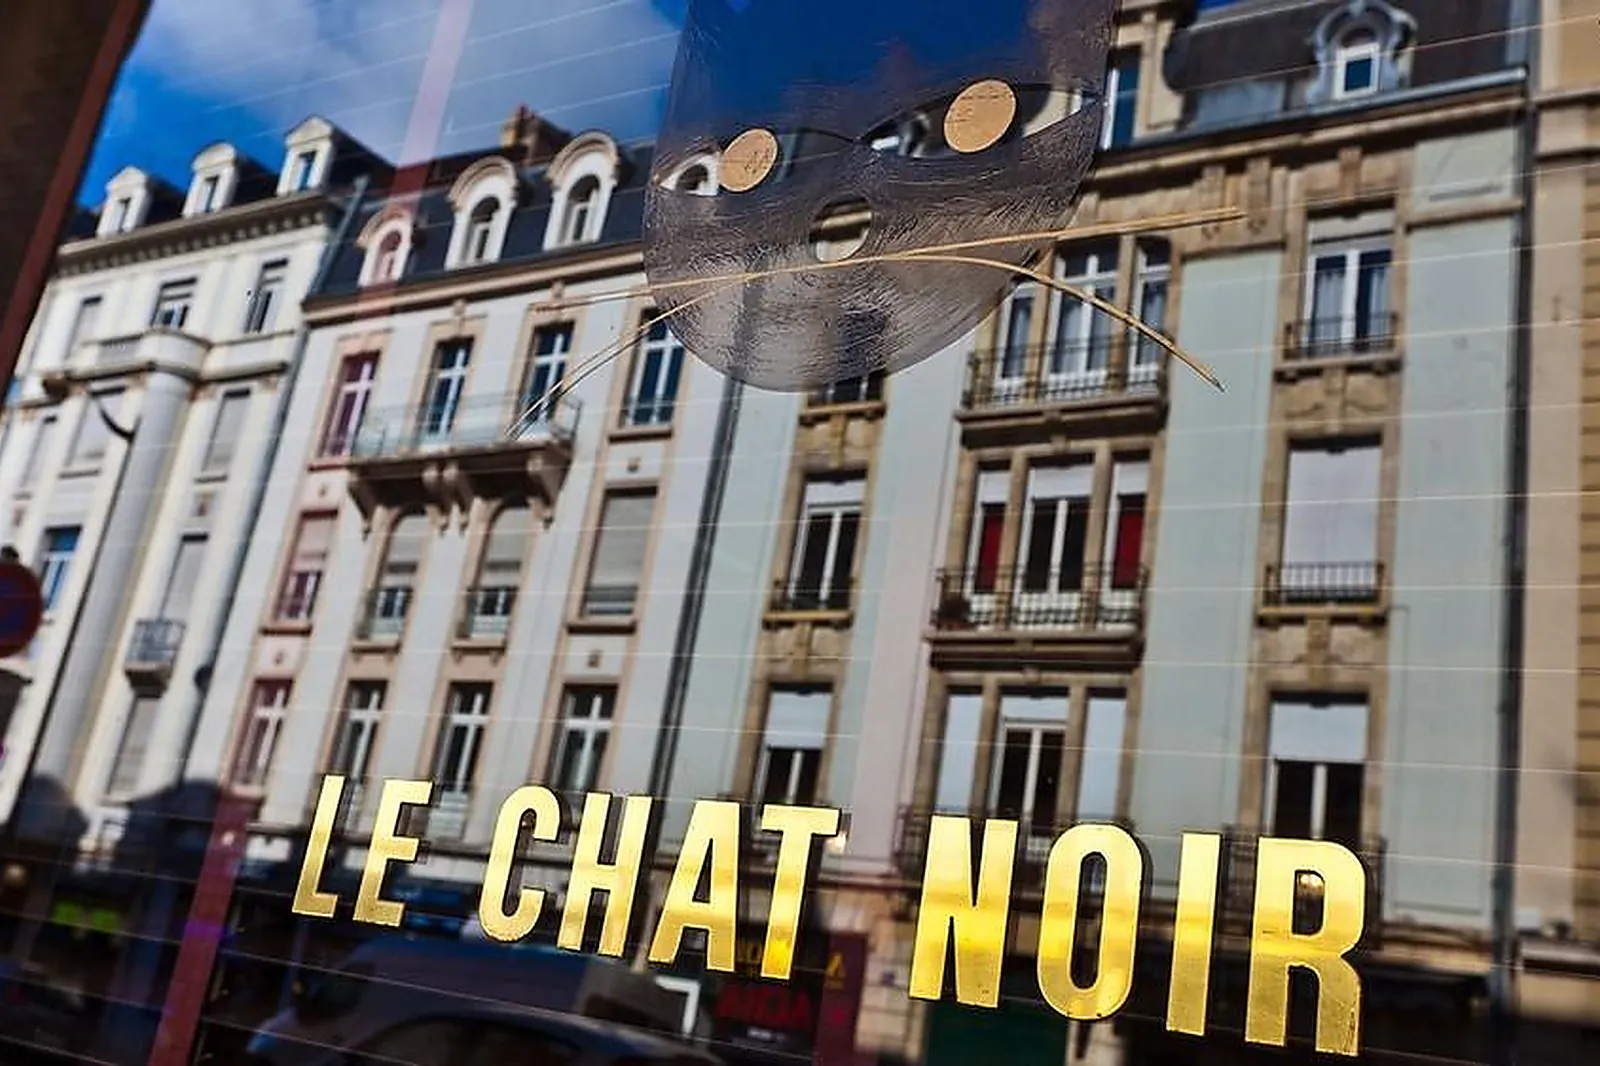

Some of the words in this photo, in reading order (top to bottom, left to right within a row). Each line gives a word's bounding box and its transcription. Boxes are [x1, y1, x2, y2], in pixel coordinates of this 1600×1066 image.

[292, 775, 433, 927] LE
[477, 785, 840, 980] CHAT
[909, 815, 1366, 1057] NOIR
